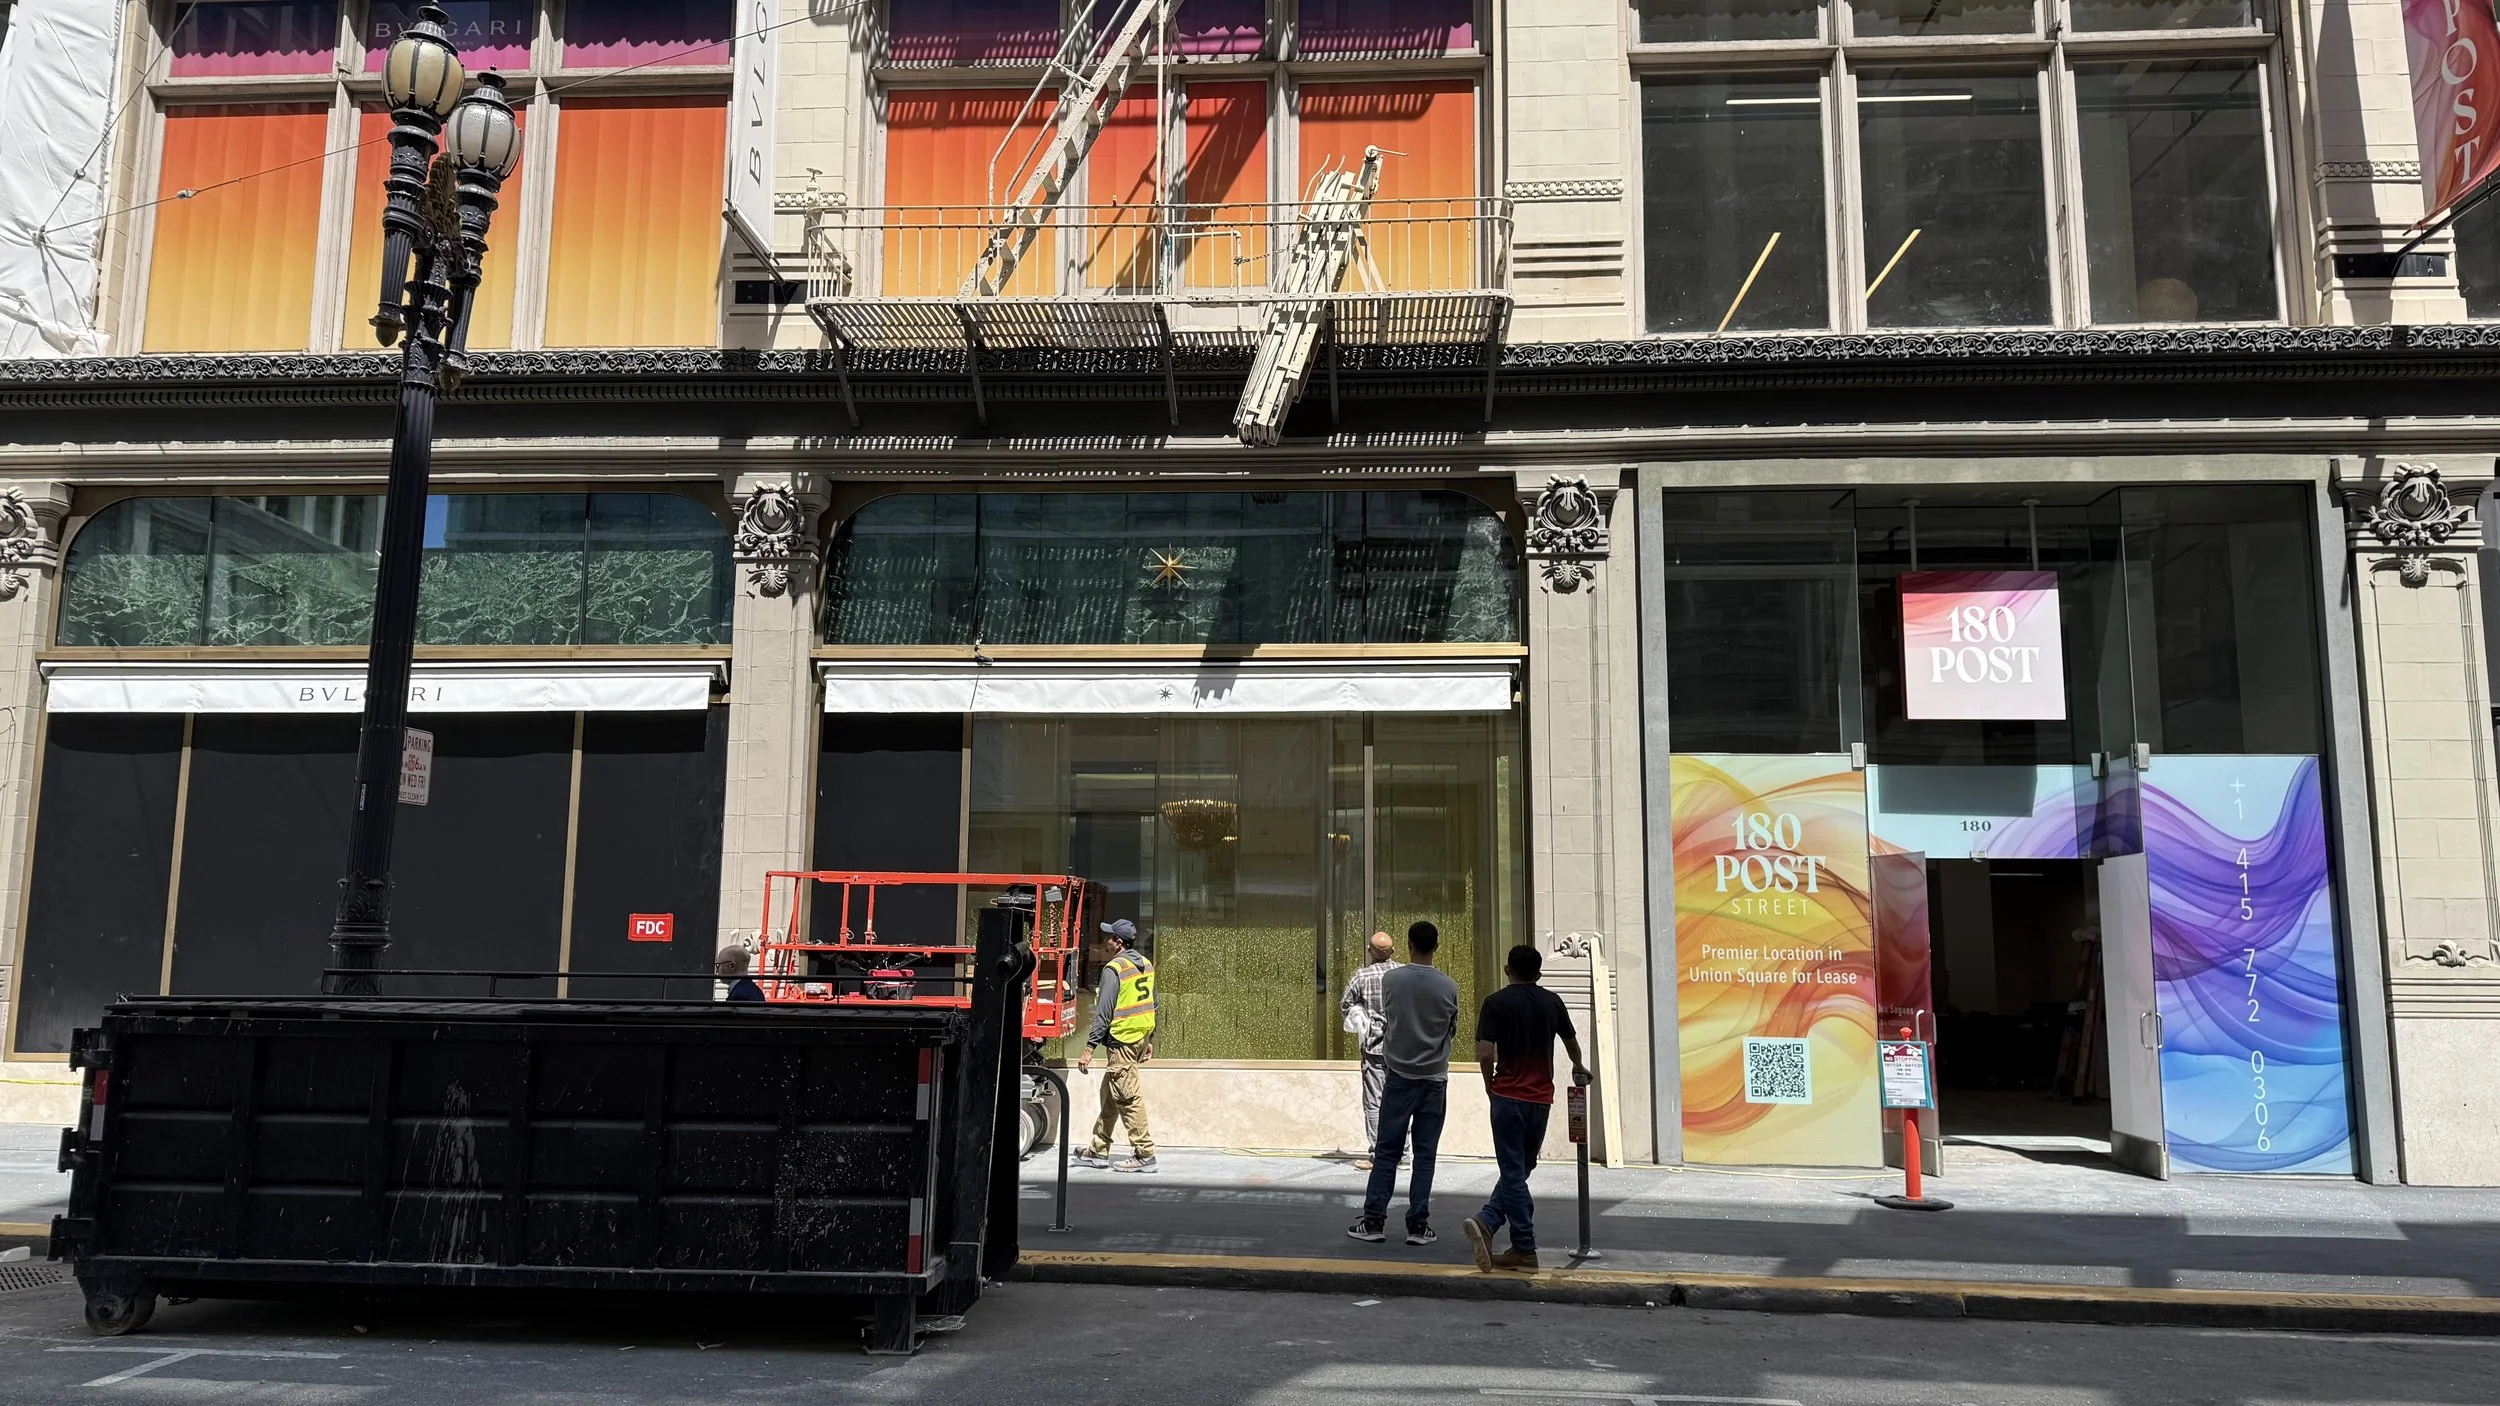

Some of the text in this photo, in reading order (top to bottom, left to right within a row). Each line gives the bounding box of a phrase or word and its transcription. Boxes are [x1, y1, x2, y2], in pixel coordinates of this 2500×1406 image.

[375, 20, 521, 38] BVGARI
[2441, 0, 2480, 185] POST
[1946, 605, 2016, 643] 180
[1929, 646, 2040, 684] POST
[299, 687, 442, 701] BVLRI
[407, 735, 431, 753] PARKING
[1731, 811, 1802, 851] 180
[1959, 820, 1992, 831] 180
[1714, 854, 1827, 894] POST
[1731, 898, 1809, 916] STREET
[636, 920, 665, 935] FDC
[1702, 943, 1843, 961] Premier Location in
[1689, 966, 1857, 987] Union Square for Lease
[1134, 975, 1150, 1002] S
